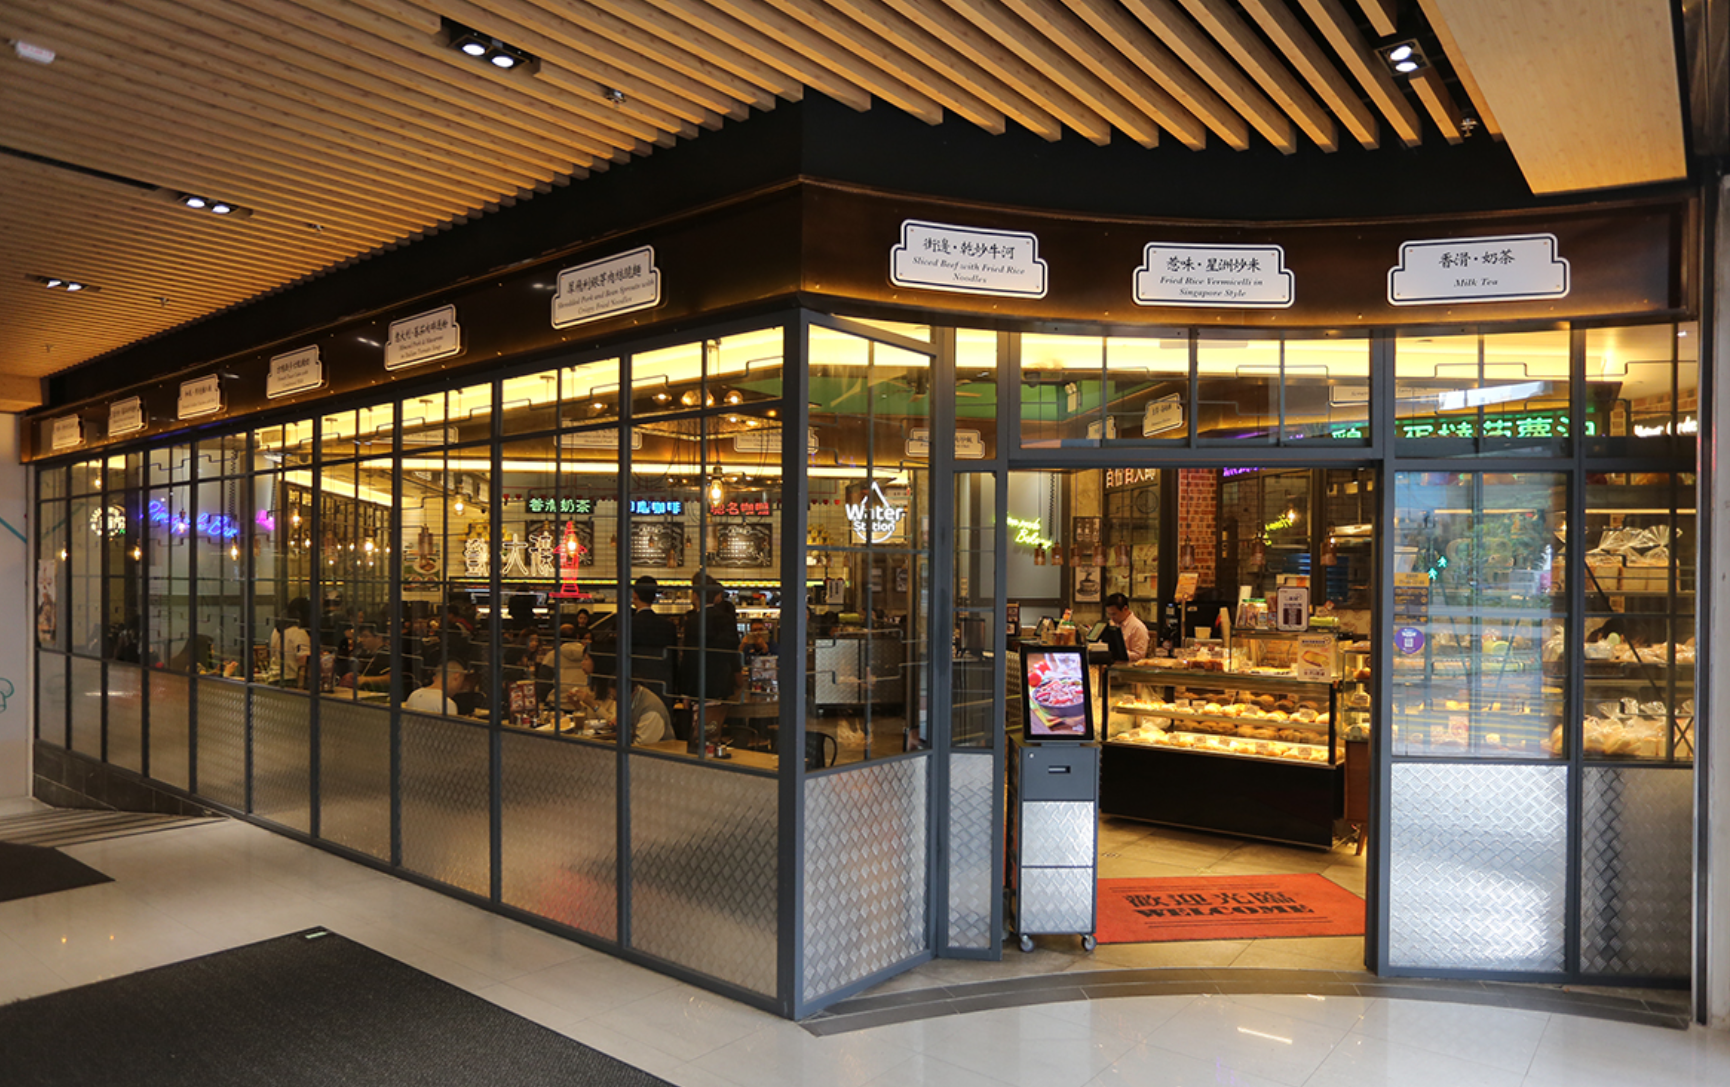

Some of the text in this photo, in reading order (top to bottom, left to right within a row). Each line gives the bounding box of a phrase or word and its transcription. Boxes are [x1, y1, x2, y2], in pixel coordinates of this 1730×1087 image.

[911, 256, 1026, 276] Sliced Beef with Fried Rice
[952, 272, 988, 284] Noodles
[1159, 276, 1183, 285] Fried
[1184, 276, 1205, 285] Rice
[1206, 277, 1252, 287] Vermicelli
[1453, 277, 1499, 288] Milk Tea
[1178, 288, 1247, 299] Singapore Style
[852, 520, 896, 533] Sttion
[1133, 904, 1316, 918] WELCOME
